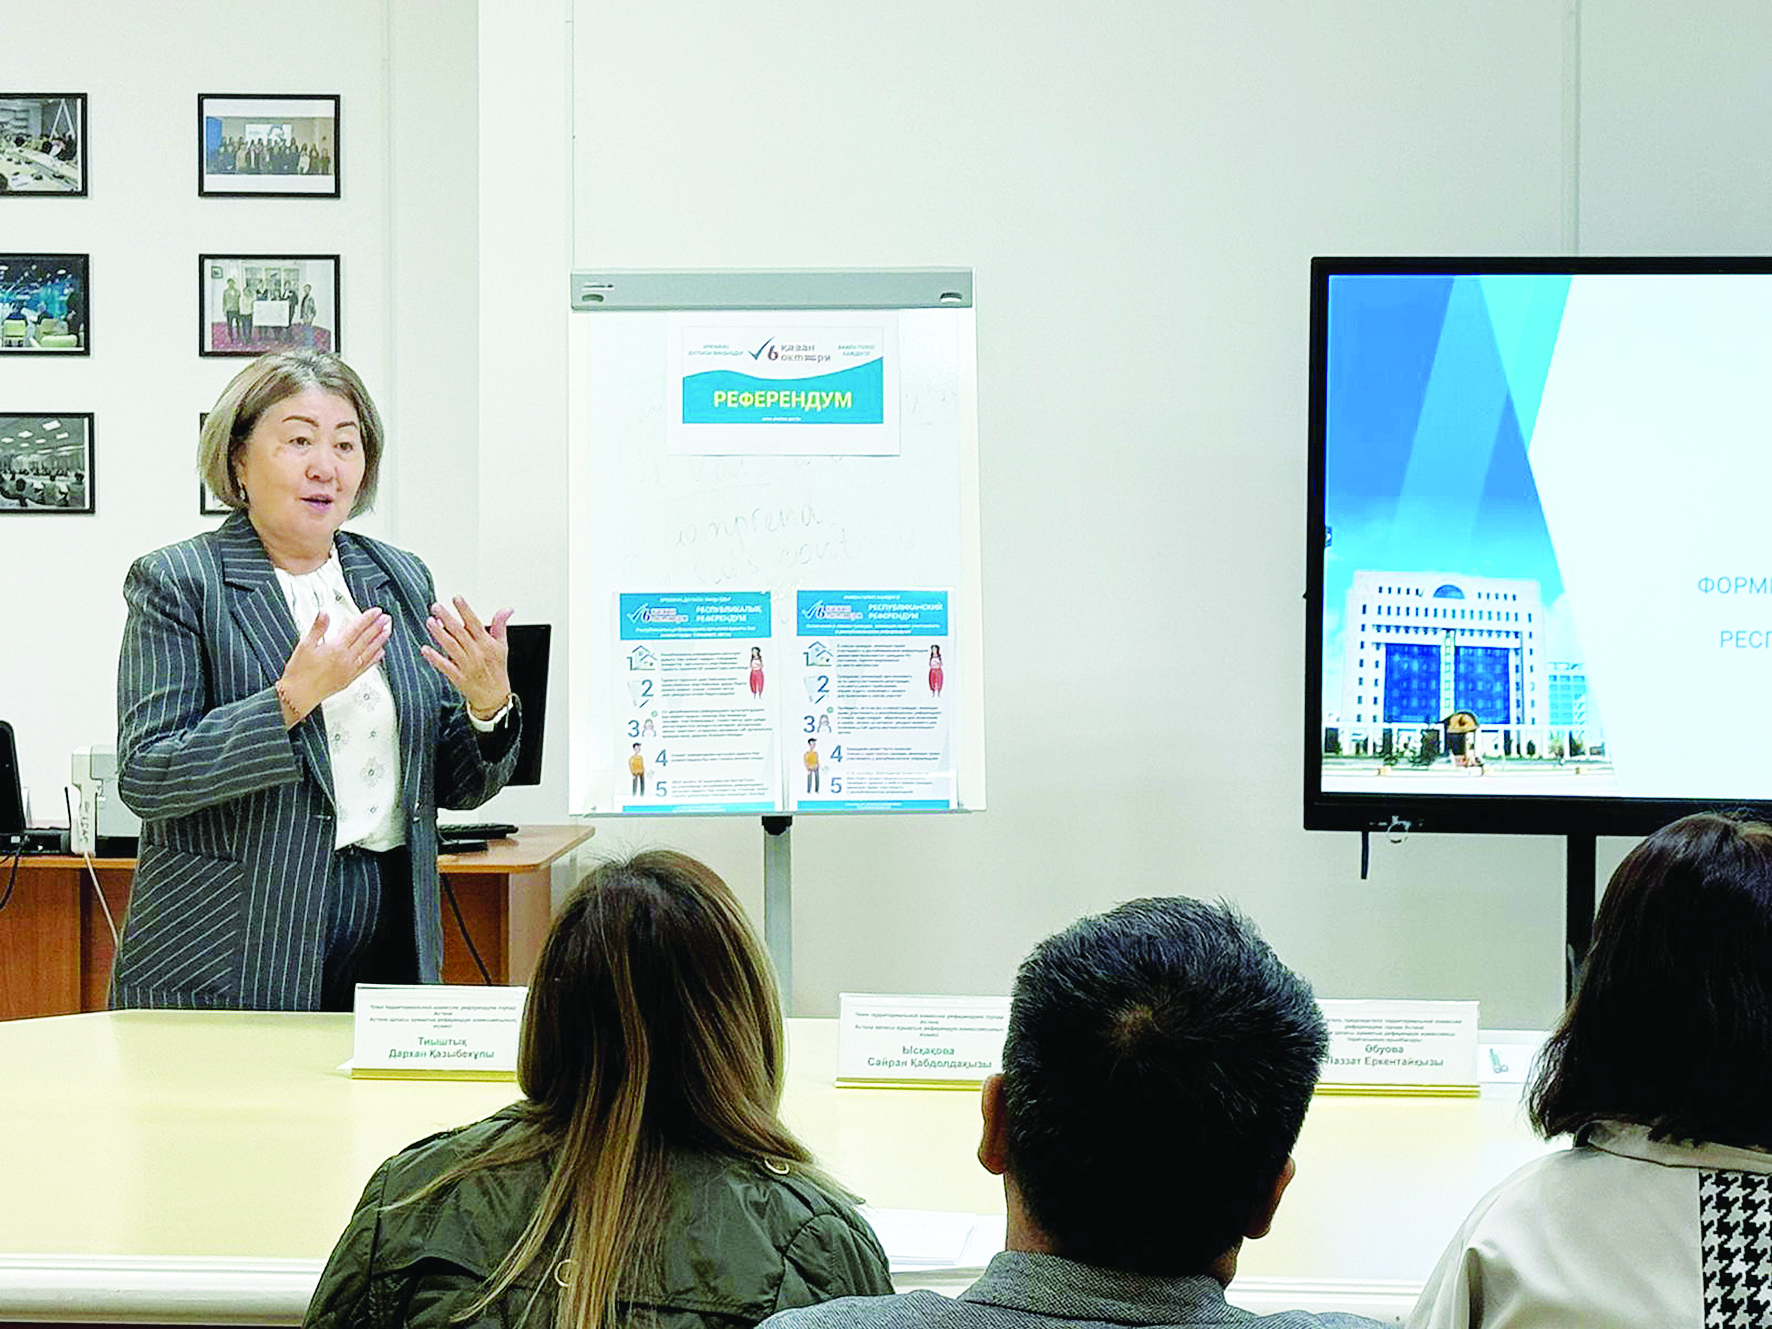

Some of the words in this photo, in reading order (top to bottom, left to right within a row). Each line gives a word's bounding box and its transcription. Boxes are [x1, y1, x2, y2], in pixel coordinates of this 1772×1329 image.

[767, 345, 779, 361] 6
[713, 390, 852, 412] РЕФЕРЕНДУМ
[1698, 575, 1772, 594] ФОРМ
[641, 679, 654, 697] 2
[817, 675, 830, 693] 2
[627, 719, 640, 738] 3
[803, 715, 816, 733] 3
[655, 749, 669, 767] 4
[830, 745, 843, 763] 4
[655, 781, 668, 798] 5
[830, 777, 842, 794] 5
[389, 1049, 427, 1059] Дархан
[902, 1045, 955, 1056] Ысқақова
[867, 1056, 908, 1068] Сайран
